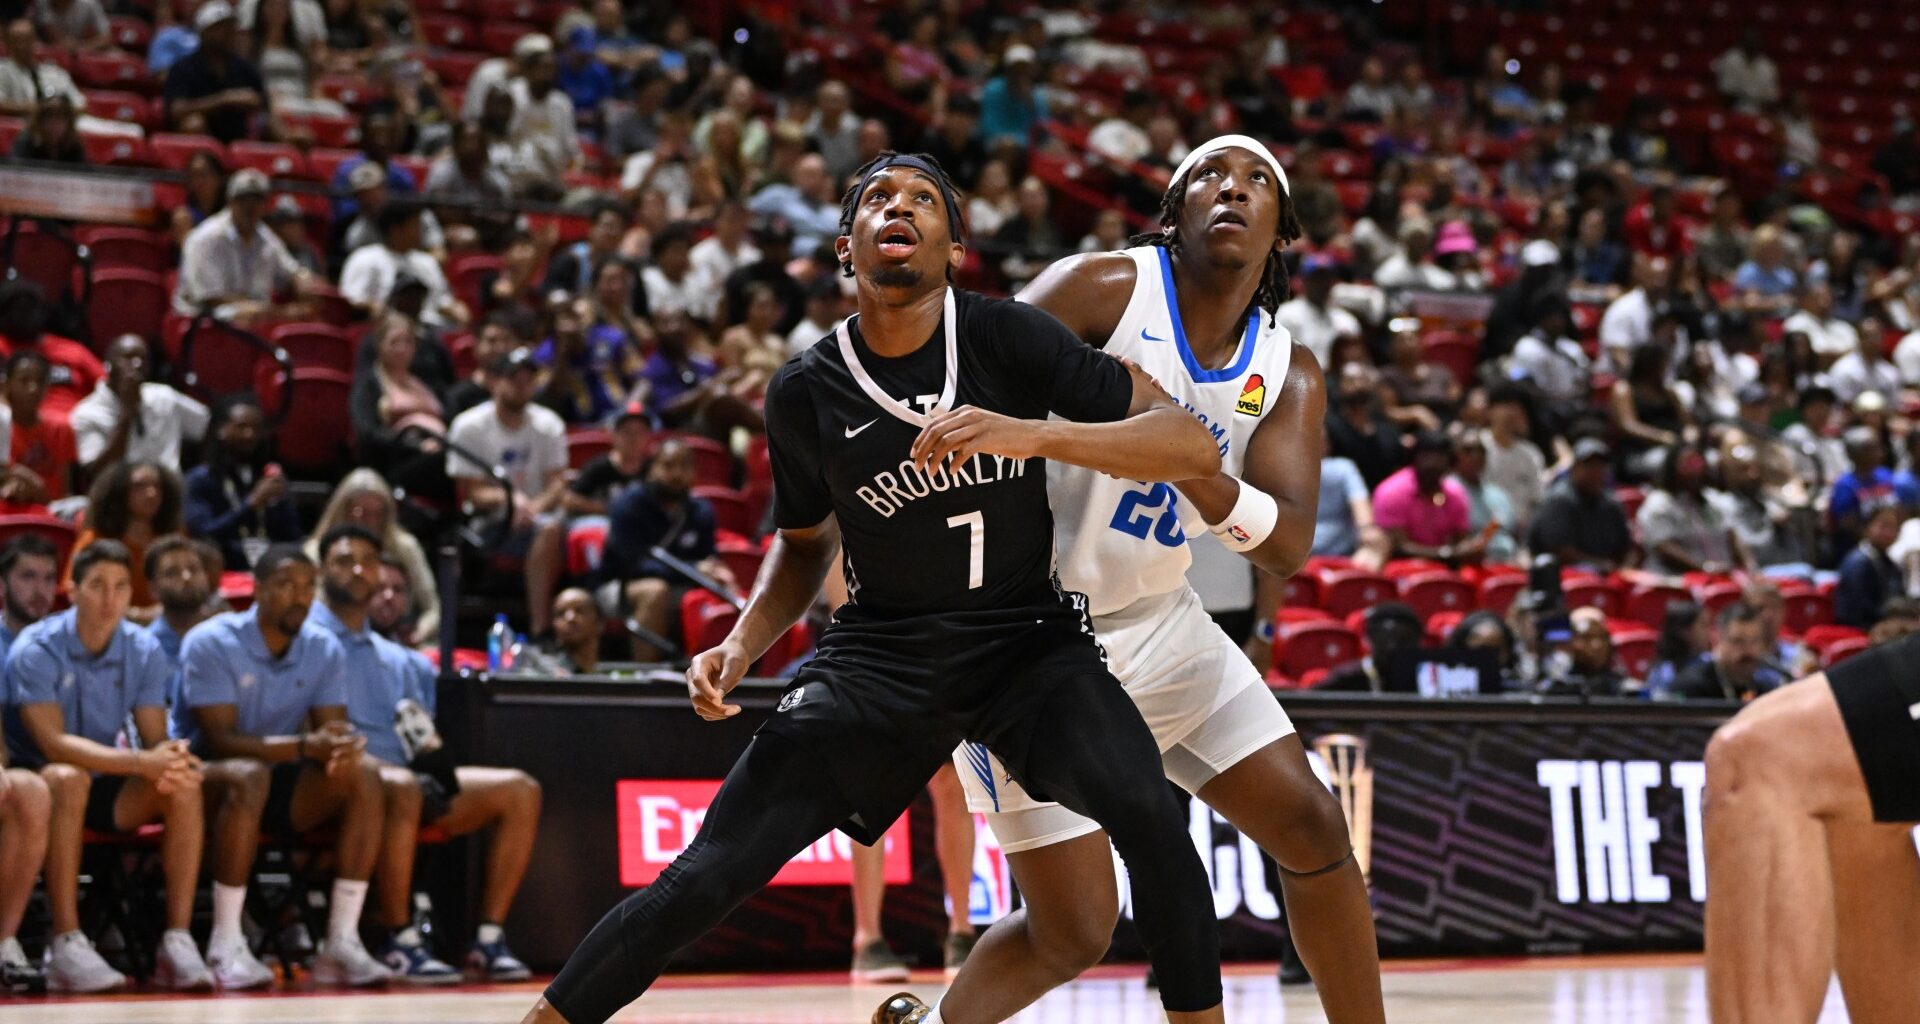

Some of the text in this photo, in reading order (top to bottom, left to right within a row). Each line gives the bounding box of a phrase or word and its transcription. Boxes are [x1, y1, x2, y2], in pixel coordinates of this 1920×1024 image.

[1237, 399, 1260, 413] ves
[946, 510, 985, 590] 7
[1536, 760, 1671, 903] THE
